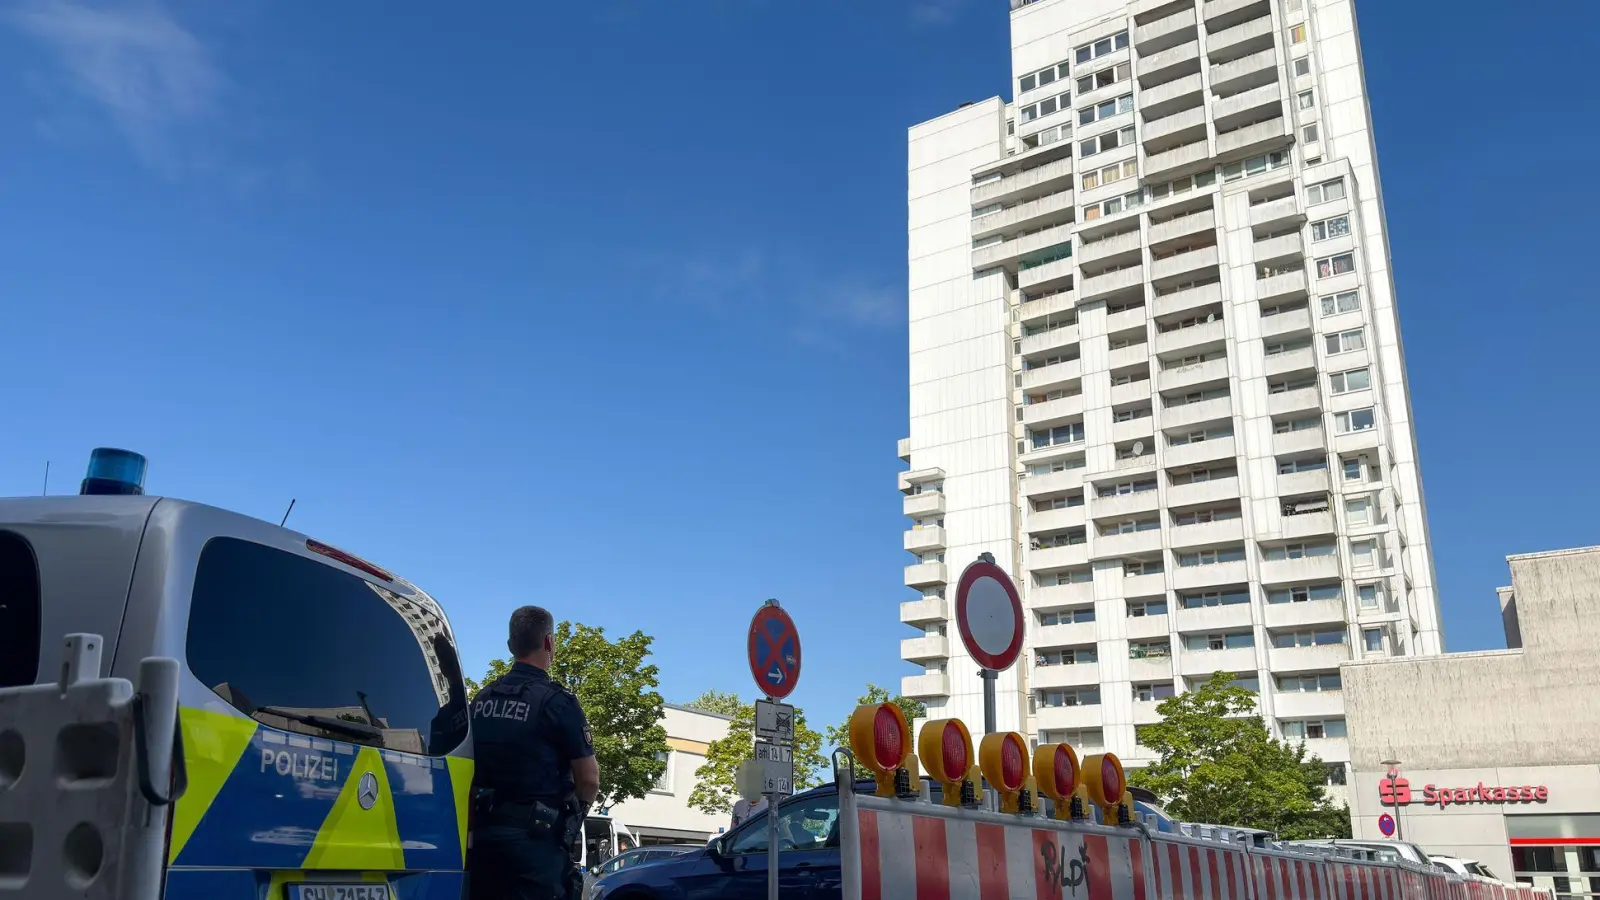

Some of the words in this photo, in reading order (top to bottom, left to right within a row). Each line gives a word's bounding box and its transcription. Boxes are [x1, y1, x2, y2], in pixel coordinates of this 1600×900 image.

[473, 699, 531, 721] POLIZEI
[261, 749, 338, 781] POLIZEI
[1423, 782, 1549, 807] Sparkasse
